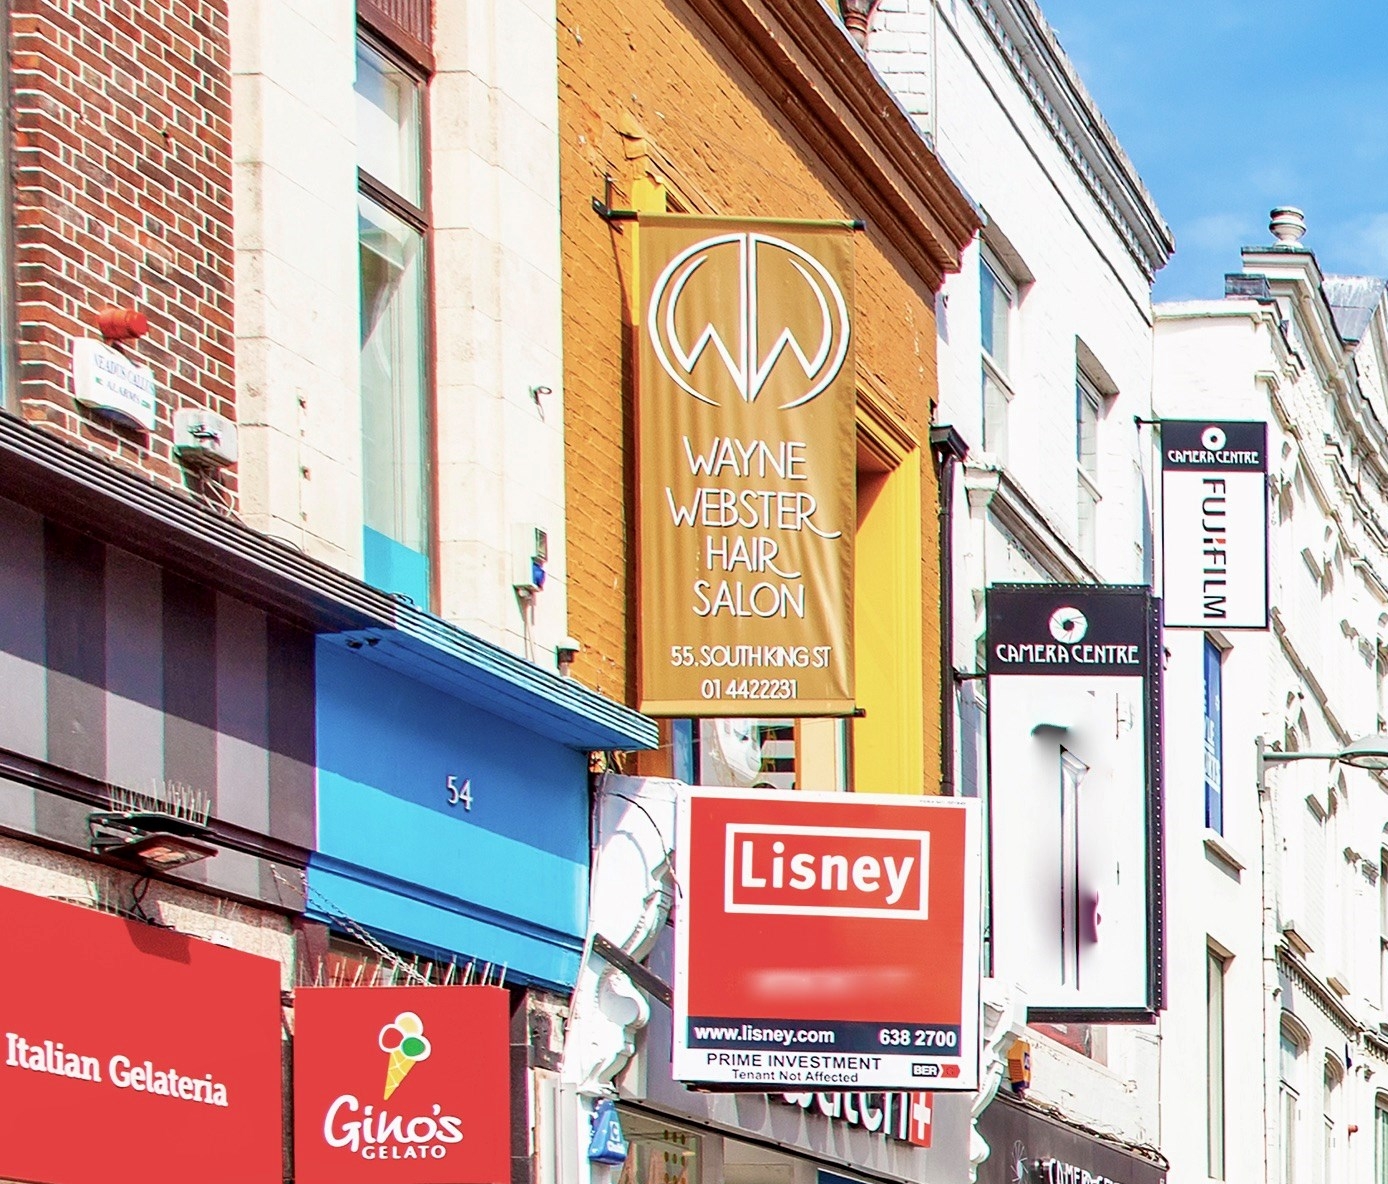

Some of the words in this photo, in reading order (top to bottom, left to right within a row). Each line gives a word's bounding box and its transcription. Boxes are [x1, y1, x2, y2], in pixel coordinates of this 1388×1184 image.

[683, 435, 808, 481] WAYNE
[1167, 449, 1215, 464] CAMERA
[1216, 450, 1260, 465] CENTRE
[665, 487, 842, 539] WEBSTER
[706, 535, 802, 578] HAIR
[1201, 478, 1227, 619] FUJIFILM
[692, 579, 806, 619] SALON
[699, 645, 762, 668] SOUTH
[765, 645, 810, 668] KING
[811, 645, 832, 669] ST
[995, 643, 1070, 664] CAMERA
[1072, 645, 1140, 665] CENTRE
[700, 679, 721, 700] 01
[725, 679, 798, 700] 4422231
[446, 775, 474, 811] 54
[741, 840, 915, 906] Lisney
[693, 1024, 836, 1047] www.lisney.com
[879, 1027, 910, 1046] 638
[914, 1028, 958, 1048] 2700
[5, 1032, 102, 1083] Italian
[108, 1054, 229, 1108] Gelateria
[707, 1052, 762, 1068] PRIME
[768, 1053, 882, 1070] INVESTMENT
[731, 1069, 775, 1081] Tenant
[779, 1070, 801, 1082] Not
[805, 1071, 859, 1083] Affected
[912, 1064, 938, 1077] BER
[323, 1094, 464, 1153] Gino's
[361, 1144, 447, 1160] GELATO
